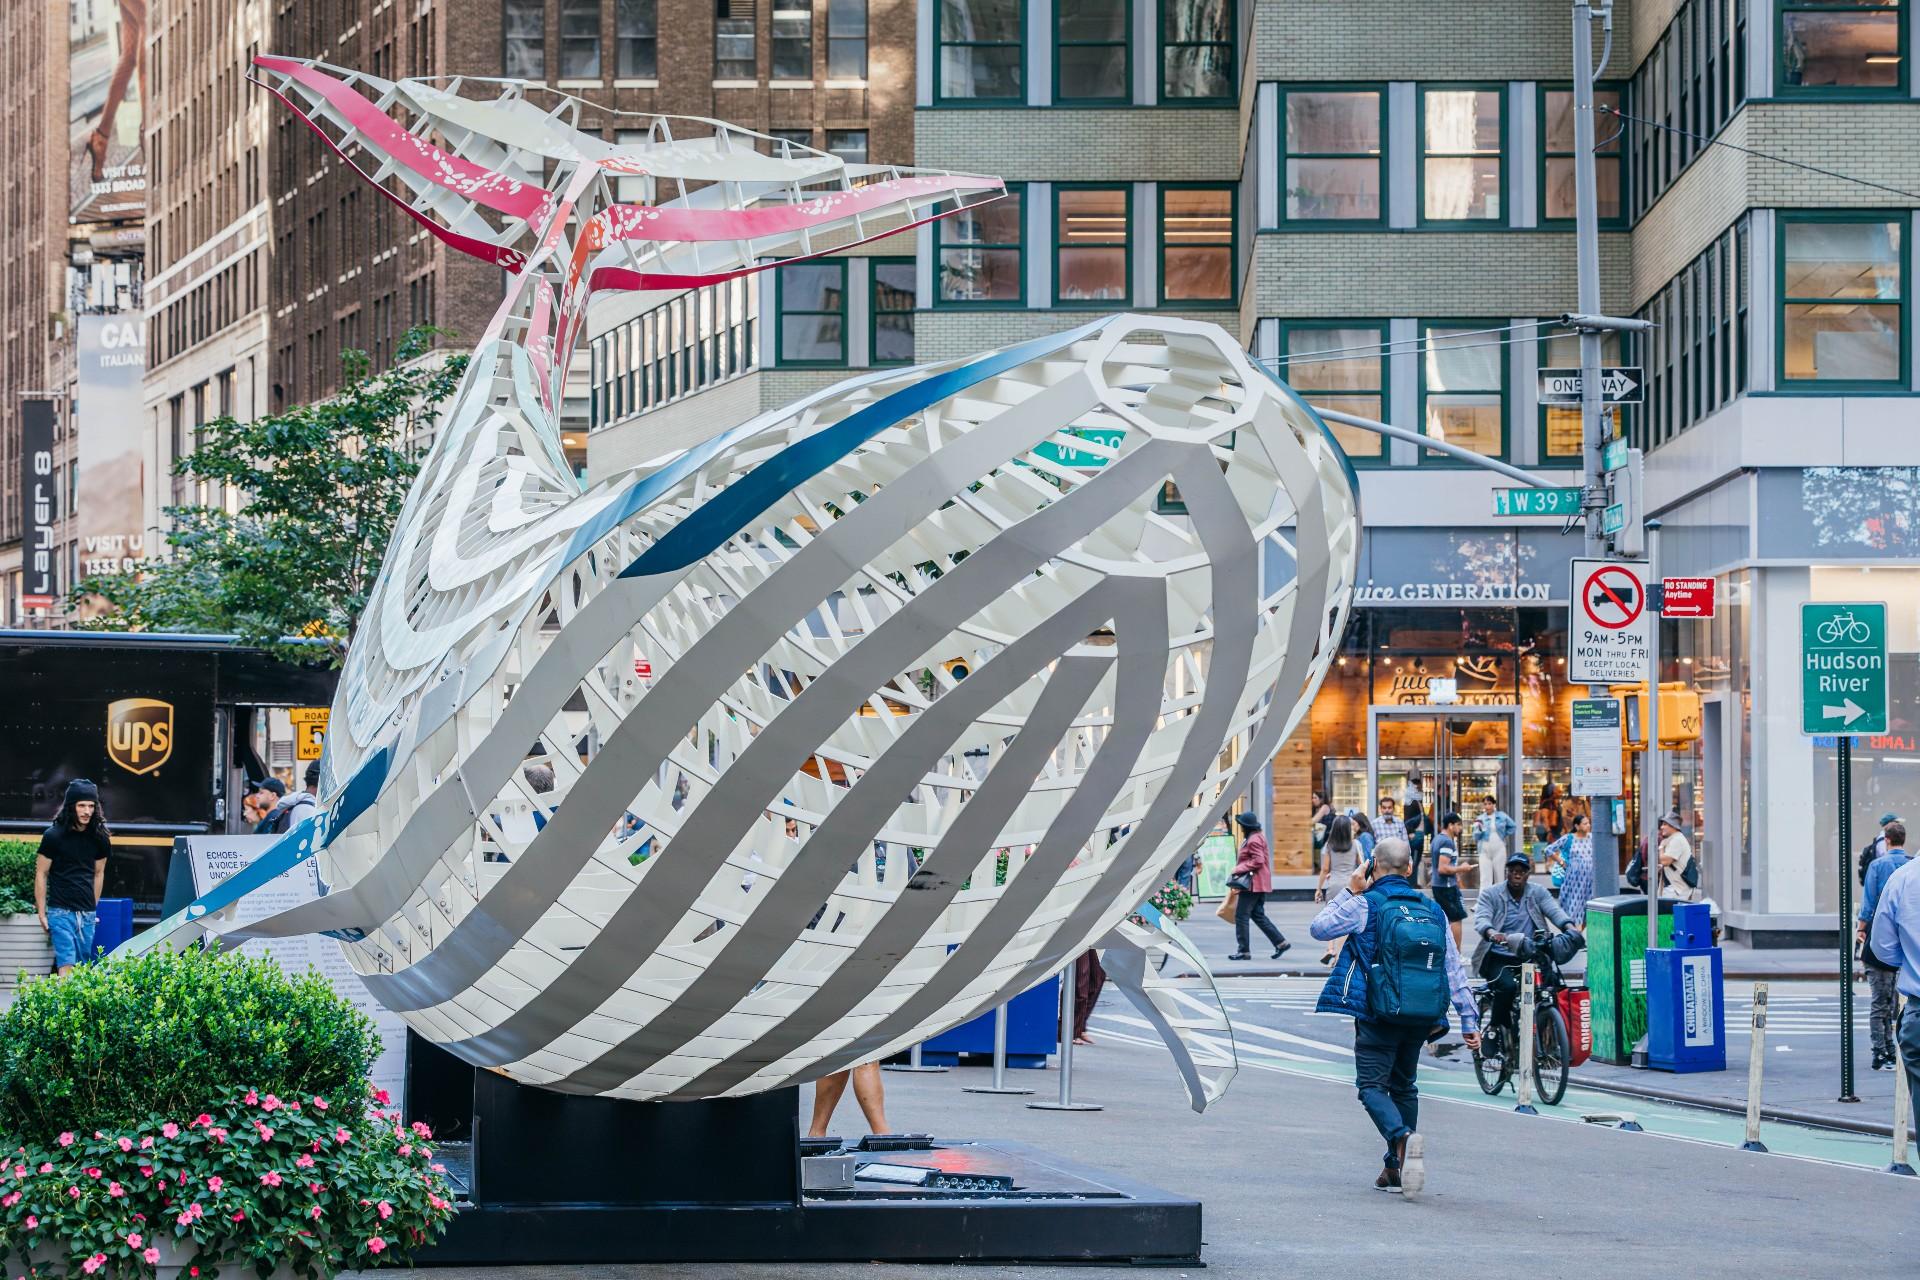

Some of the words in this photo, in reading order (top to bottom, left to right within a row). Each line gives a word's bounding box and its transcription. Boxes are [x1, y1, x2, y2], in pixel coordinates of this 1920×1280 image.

[1553, 379, 1582, 391] ONE
[34, 450, 52, 476] 8
[1514, 492, 1528, 512] W
[1535, 491, 1558, 512] 39
[1565, 491, 1579, 503] ST
[85, 535, 126, 552] VISIT
[85, 558, 119, 575] 1333
[1400, 583, 1551, 601] GENERATION
[1664, 581, 1674, 590] NO
[1675, 581, 1707, 590] STANDING
[1664, 590, 1693, 600] Anytime
[1584, 630, 1608, 644] 9AM
[1617, 631, 1643, 645] 5PM
[1577, 647, 1602, 658] MON
[1631, 649, 1649, 658] FRI
[1615, 661, 1641, 669] LOCAL
[1806, 652, 1882, 670] Hudson
[1590, 669, 1635, 678] DELIVERIES
[1819, 674, 1870, 692] River
[304, 712, 329, 720] ROAD
[111, 721, 169, 763] ups
[206, 851, 238, 860] ECHOES
[208, 861, 215, 870] A
[215, 861, 239, 870] VOICE
[1580, 999, 1591, 1052] GRUBHUB
